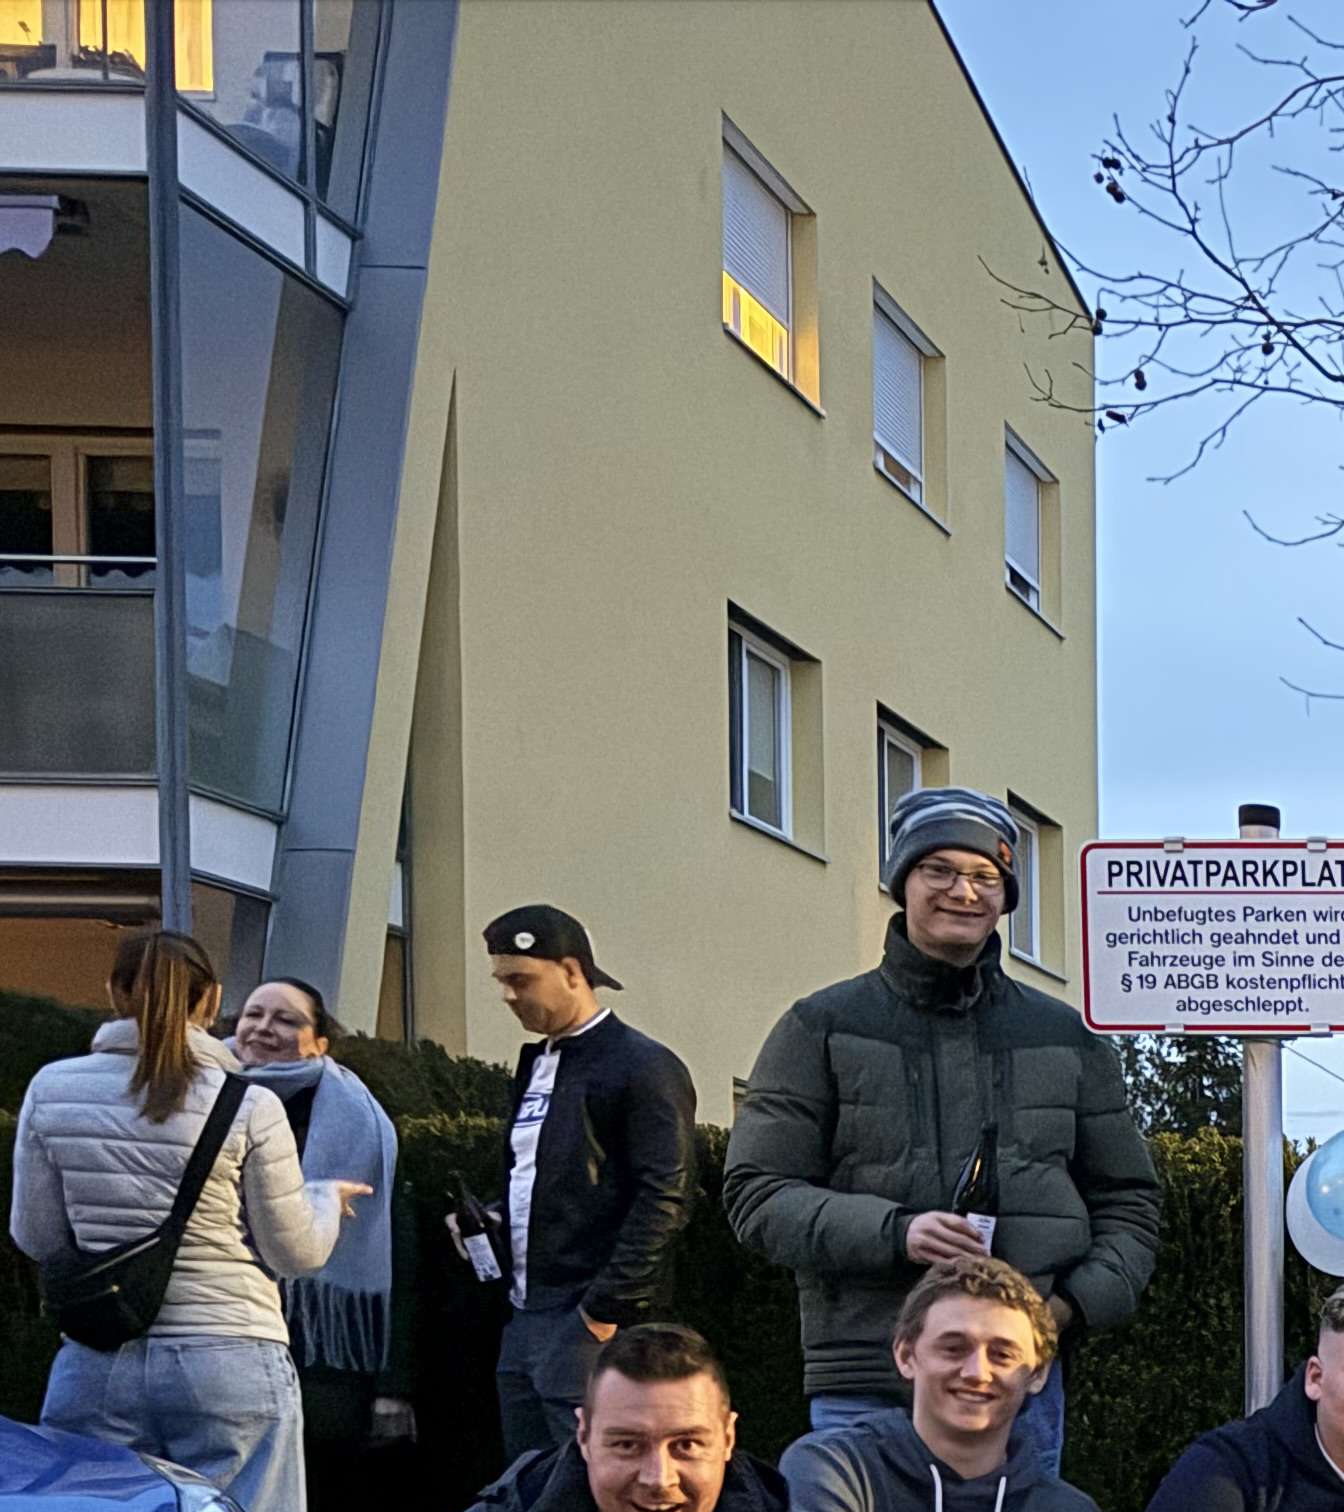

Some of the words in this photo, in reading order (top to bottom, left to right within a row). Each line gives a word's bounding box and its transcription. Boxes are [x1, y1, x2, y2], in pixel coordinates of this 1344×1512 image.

[1128, 906, 1236, 925] Unbefugtes
[1243, 906, 1306, 922] Parken
[1105, 929, 1203, 948] gerichtlich
[1210, 929, 1299, 948] geahndet
[1305, 929, 1341, 945] und
[1128, 951, 1226, 970] Fahrzeuge
[1233, 951, 1254, 967] im
[1261, 951, 1314, 967] Sinne
[1121, 973, 1132, 993] §
[1137, 974, 1157, 989] 19
[1163, 974, 1219, 989] ABGB
[1175, 997, 1310, 1015] abgeschleppt.
